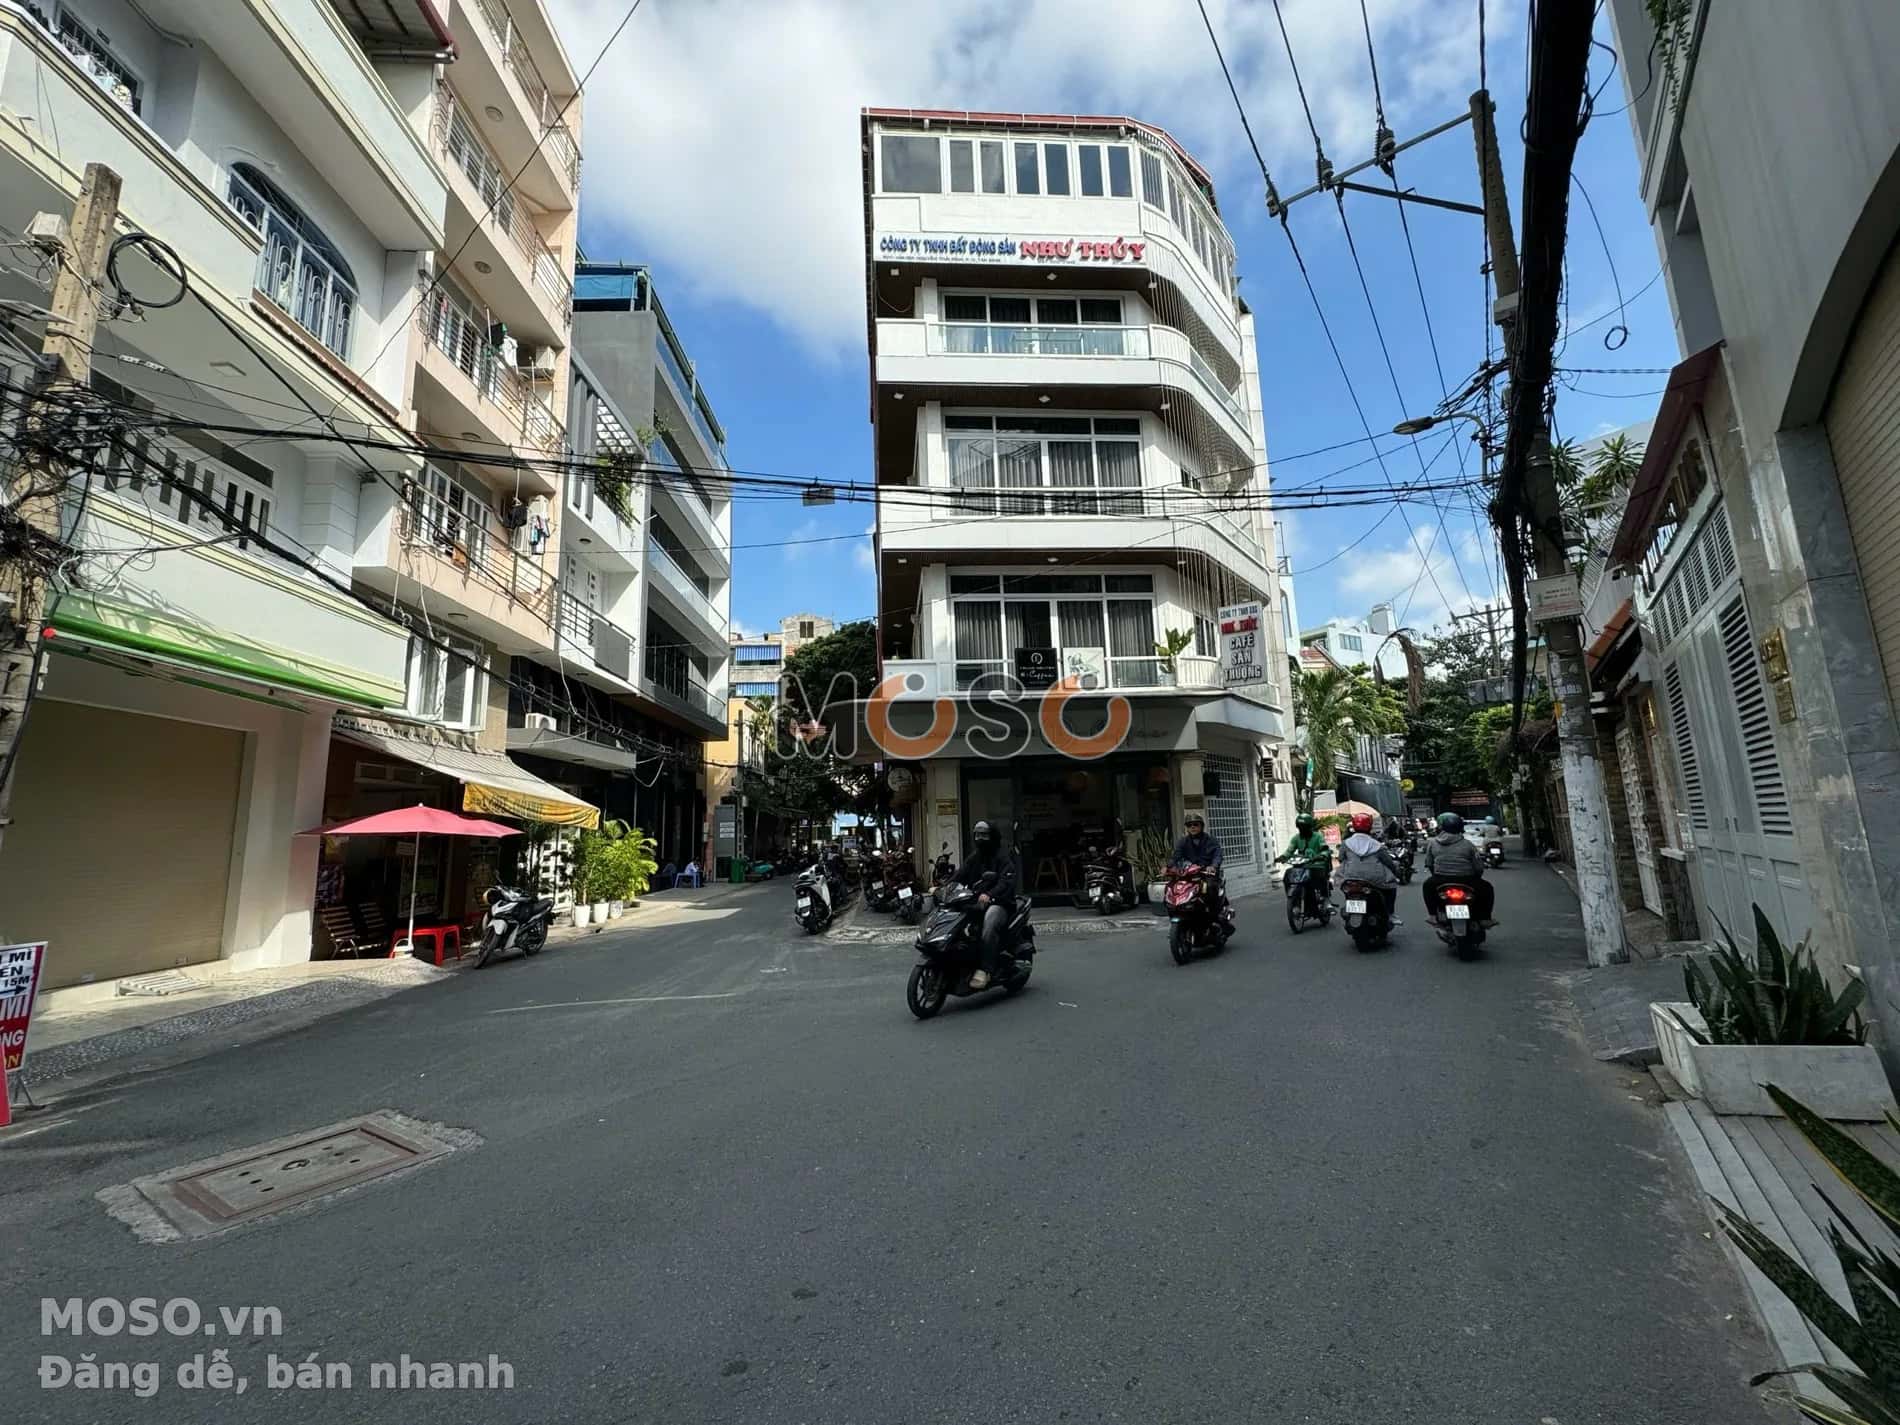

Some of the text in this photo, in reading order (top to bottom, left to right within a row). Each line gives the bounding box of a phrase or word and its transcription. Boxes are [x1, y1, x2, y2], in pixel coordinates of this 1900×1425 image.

[880, 235, 907, 253] CÔNG
[909, 239, 921, 253] TY
[923, 239, 948, 254] TNHH
[1020, 238, 1074, 259] NHƯ
